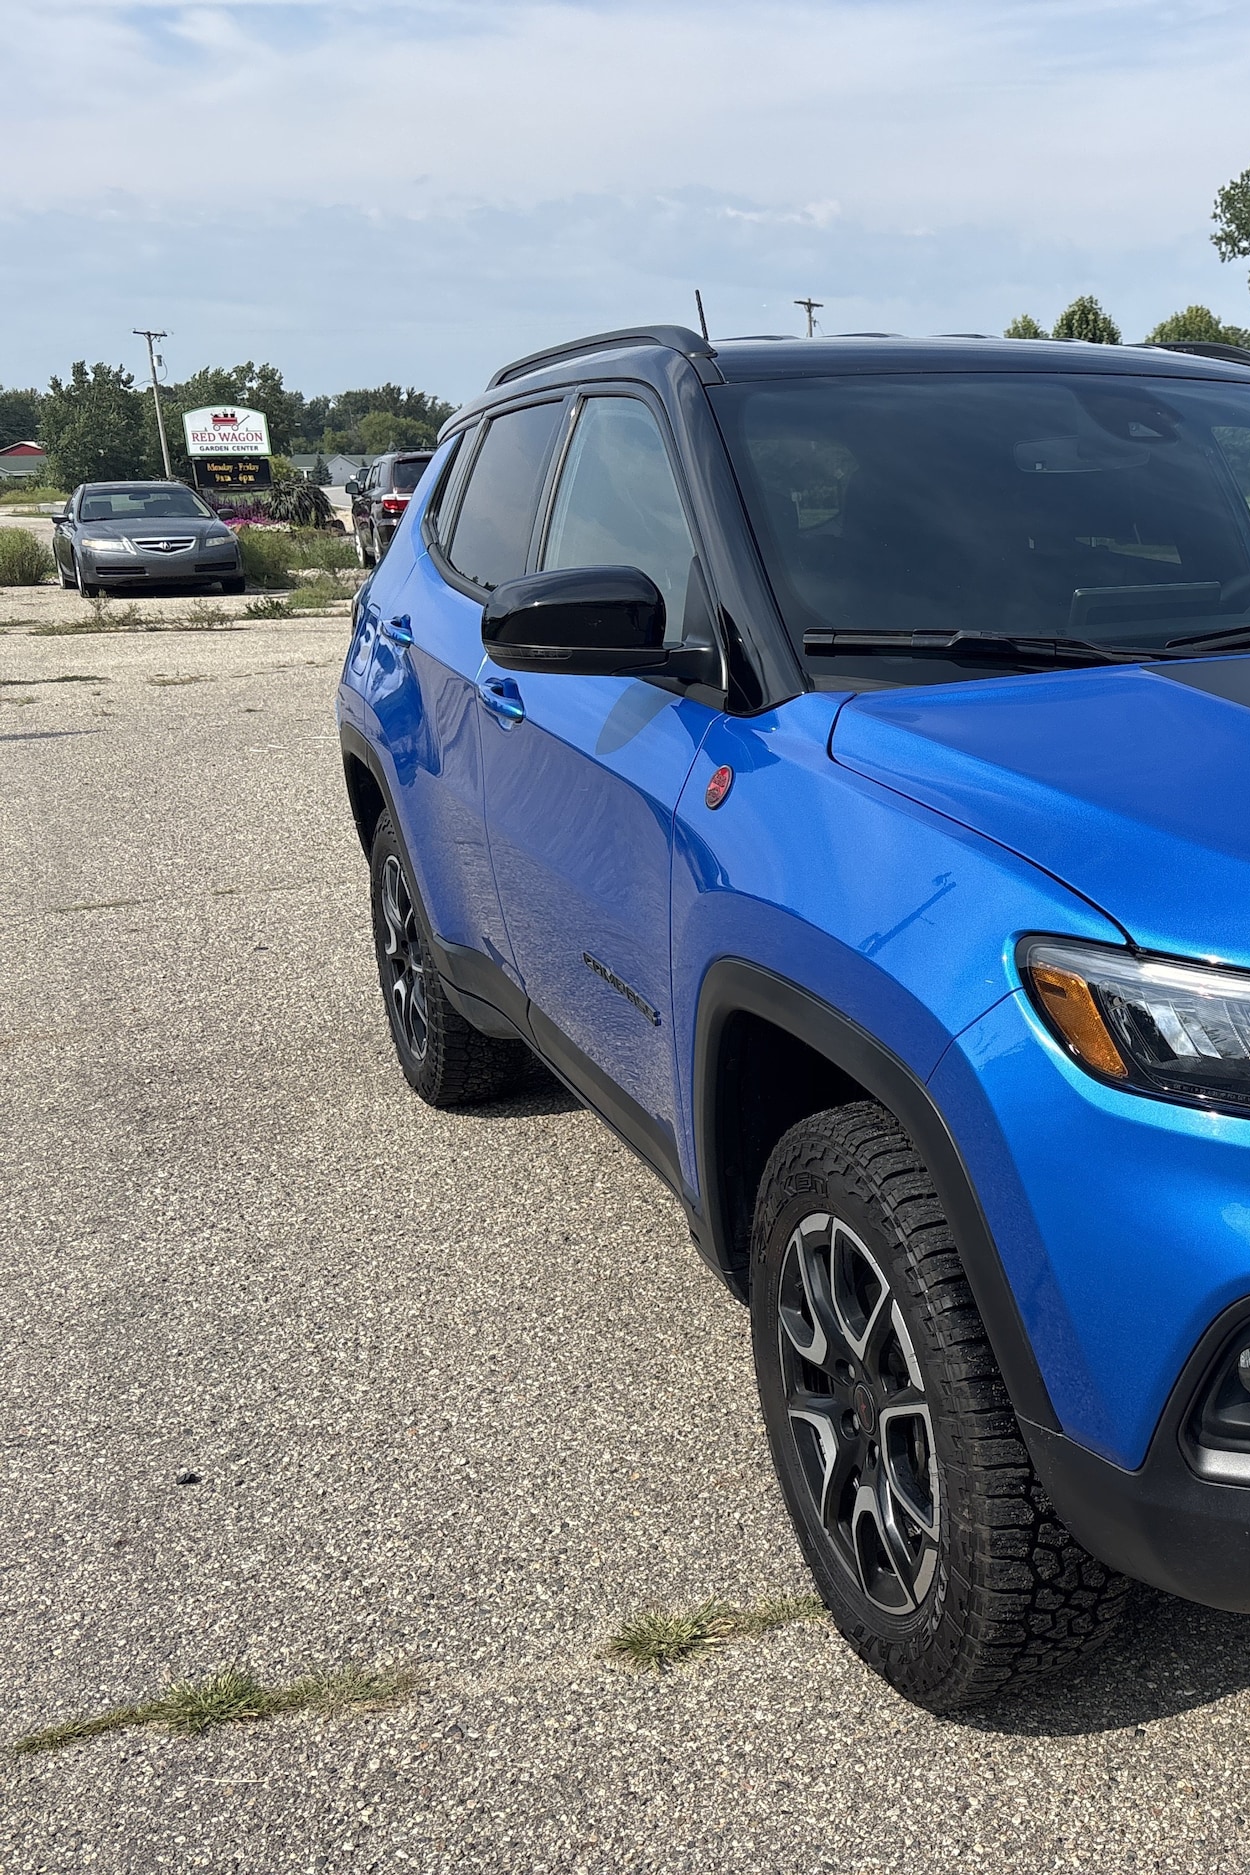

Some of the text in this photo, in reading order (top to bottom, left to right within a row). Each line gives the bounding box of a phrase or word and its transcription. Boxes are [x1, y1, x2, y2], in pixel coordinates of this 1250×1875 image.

[191, 432, 263, 442] RED WAGON
[207, 463, 233, 473] Monday
[238, 462, 260, 473] Friday
[215, 474, 231, 482] 9am
[238, 474, 255, 484] 6pm
